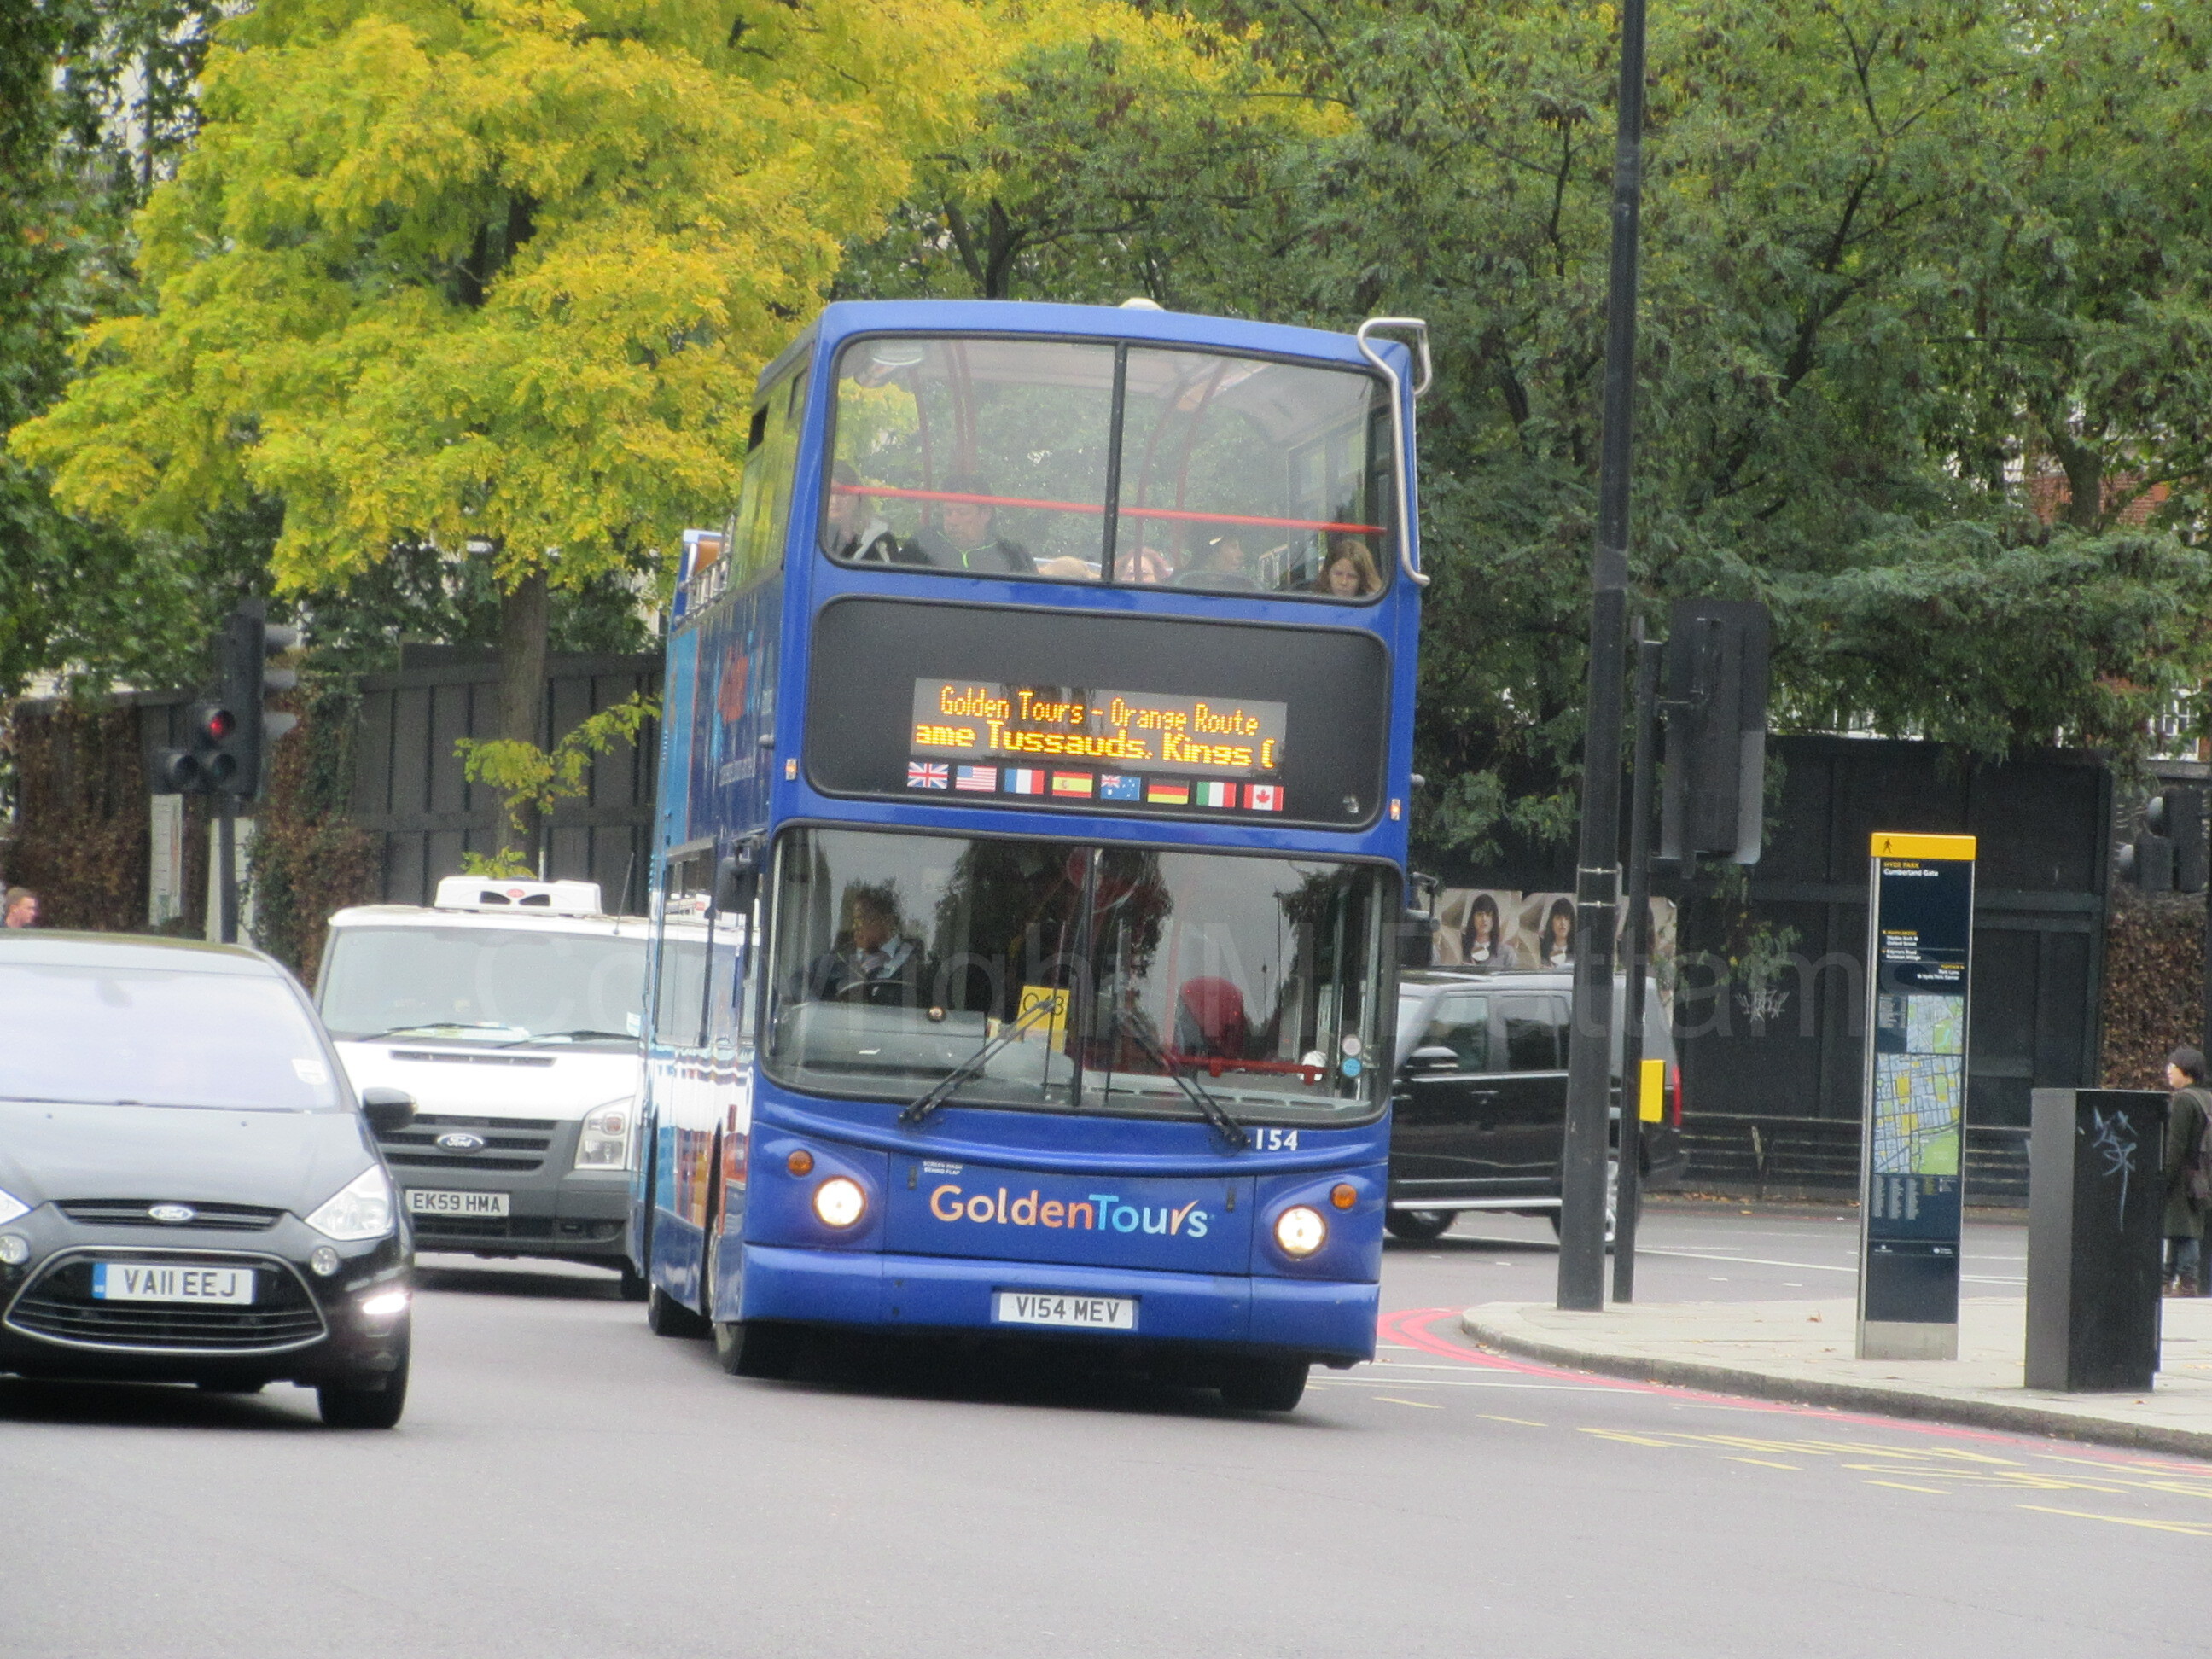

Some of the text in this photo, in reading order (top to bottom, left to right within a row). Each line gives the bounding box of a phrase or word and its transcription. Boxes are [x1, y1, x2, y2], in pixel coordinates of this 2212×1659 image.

[940, 685, 1010, 719] Golden
[1019, 690, 1083, 724] Tours
[1110, 696, 1187, 731] Orange
[1194, 701, 1260, 737] Route
[987, 719, 1153, 760] Tussauds.
[1161, 731, 1254, 766] Kings
[1256, 1129, 1299, 1151] 154
[413, 1192, 501, 1213] EK59 HMA
[929, 1183, 1209, 1238] GoldenTours
[183, 1272, 237, 1297] EEJ
[1016, 1295, 1121, 1324] V154 MEV
